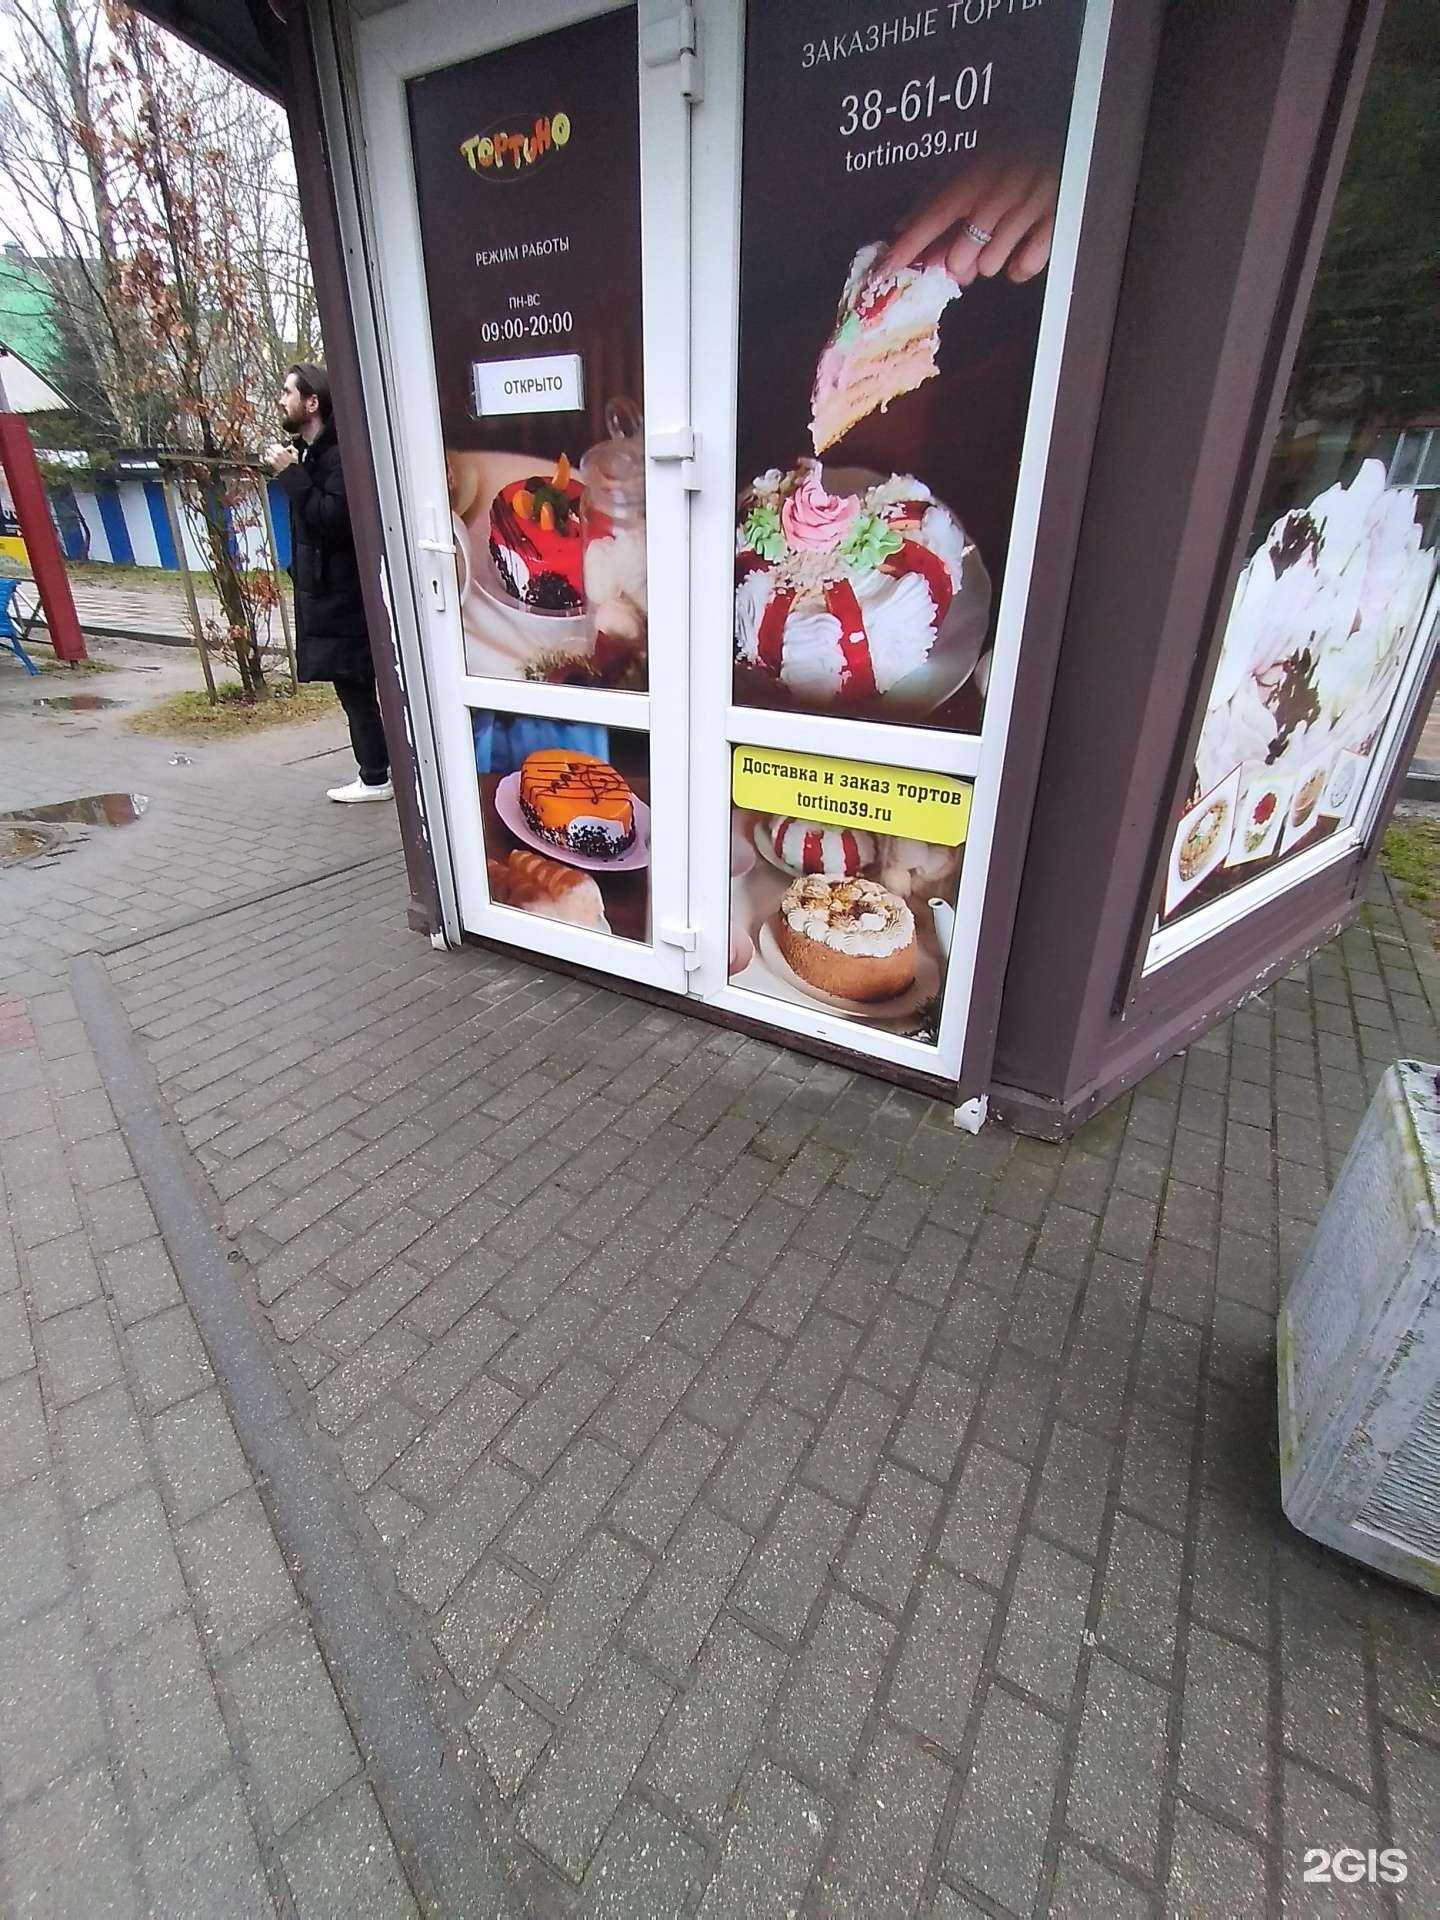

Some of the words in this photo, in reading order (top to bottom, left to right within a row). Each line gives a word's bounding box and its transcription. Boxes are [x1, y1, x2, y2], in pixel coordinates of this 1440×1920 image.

[801, 8, 938, 68] ЗАКАЗНЫЕ
[839, 62, 993, 136] 38-61-01
[845, 129, 978, 172] tortino39.ru
[475, 248, 519, 267] РЕЖИМ
[521, 236, 570, 257] РАБОТЫ
[508, 293, 541, 310] ПН-ВС
[481, 311, 573, 342] 09:00-20:00
[503, 375, 563, 396] ОТКРЫТО
[742, 757, 818, 783] Доставка
[823, 771, 834, 785] и
[839, 775, 890, 794] заказ
[896, 783, 962, 806] тортов
[797, 792, 892, 822] tortino39.ru
